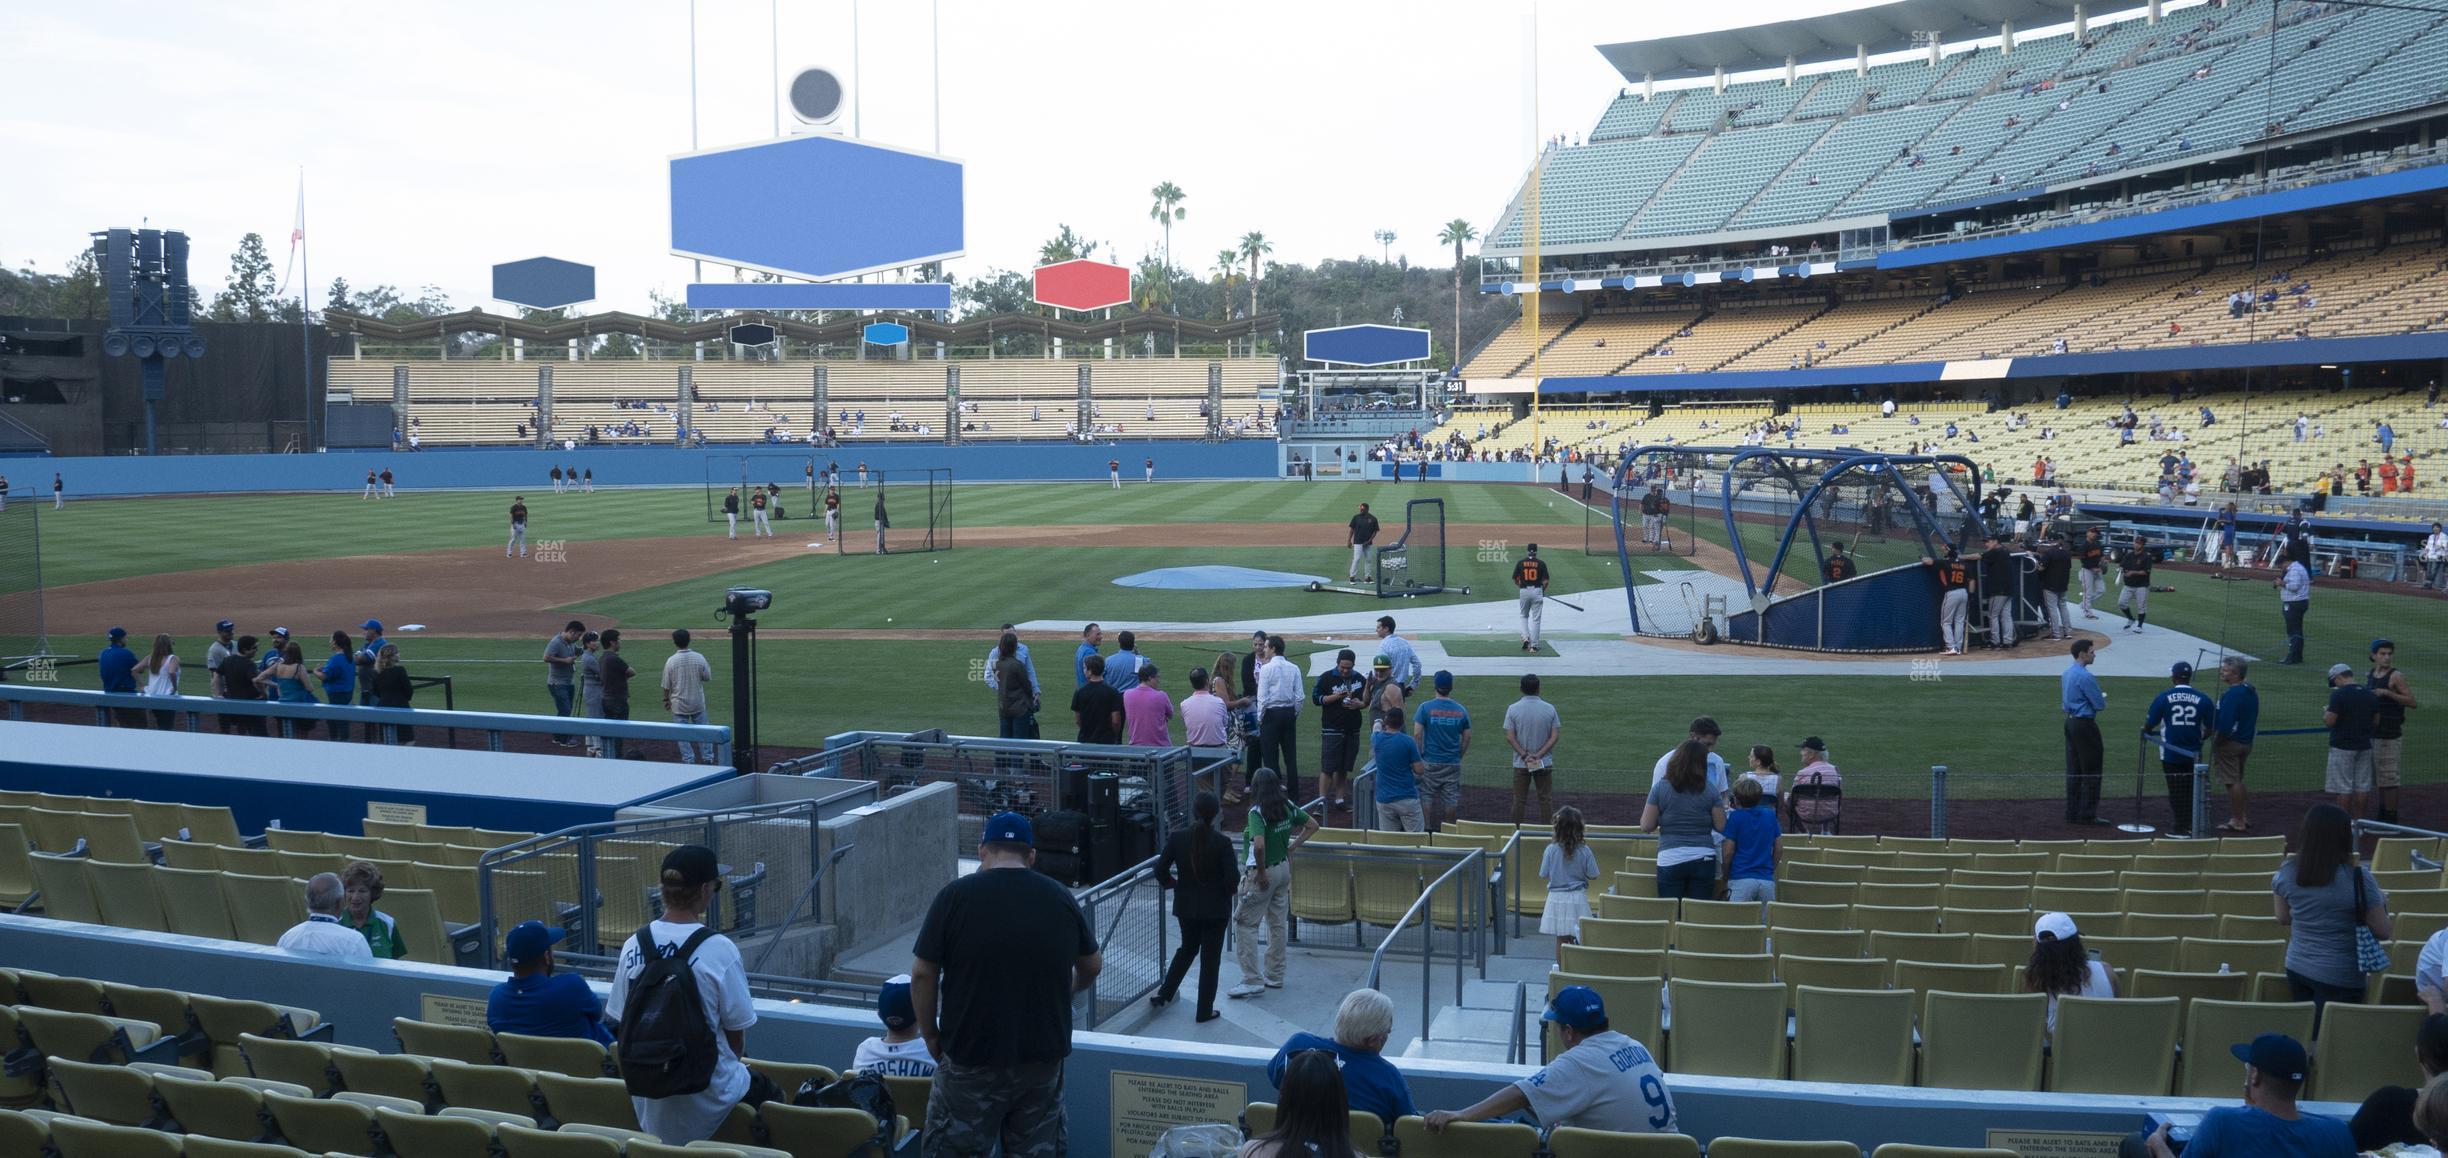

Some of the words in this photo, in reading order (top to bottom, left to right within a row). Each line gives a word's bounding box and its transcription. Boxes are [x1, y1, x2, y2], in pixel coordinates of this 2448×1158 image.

[1447, 381, 1462, 391] 5:31
[1523, 568, 1537, 581] 10
[1951, 571, 1964, 583] 16
[2167, 693, 2201, 705] KERSHAW
[2171, 705, 2197, 726] 22
[1138, 1087, 1166, 1095] ENTERING
[1179, 1090, 1202, 1098] SEATING
[1184, 1083, 1197, 1091] BATS
[1199, 1085, 1212, 1093] AND
[1213, 1087, 1229, 1095] BALLS
[1187, 1100, 1215, 1109] INTERFERE
[1640, 1074, 1670, 1129] 9
[1128, 1110, 1157, 1118] VIOLATORS
[1132, 1122, 1151, 1130] FAVOR
[1121, 1129, 1145, 1137] PELOTAS
